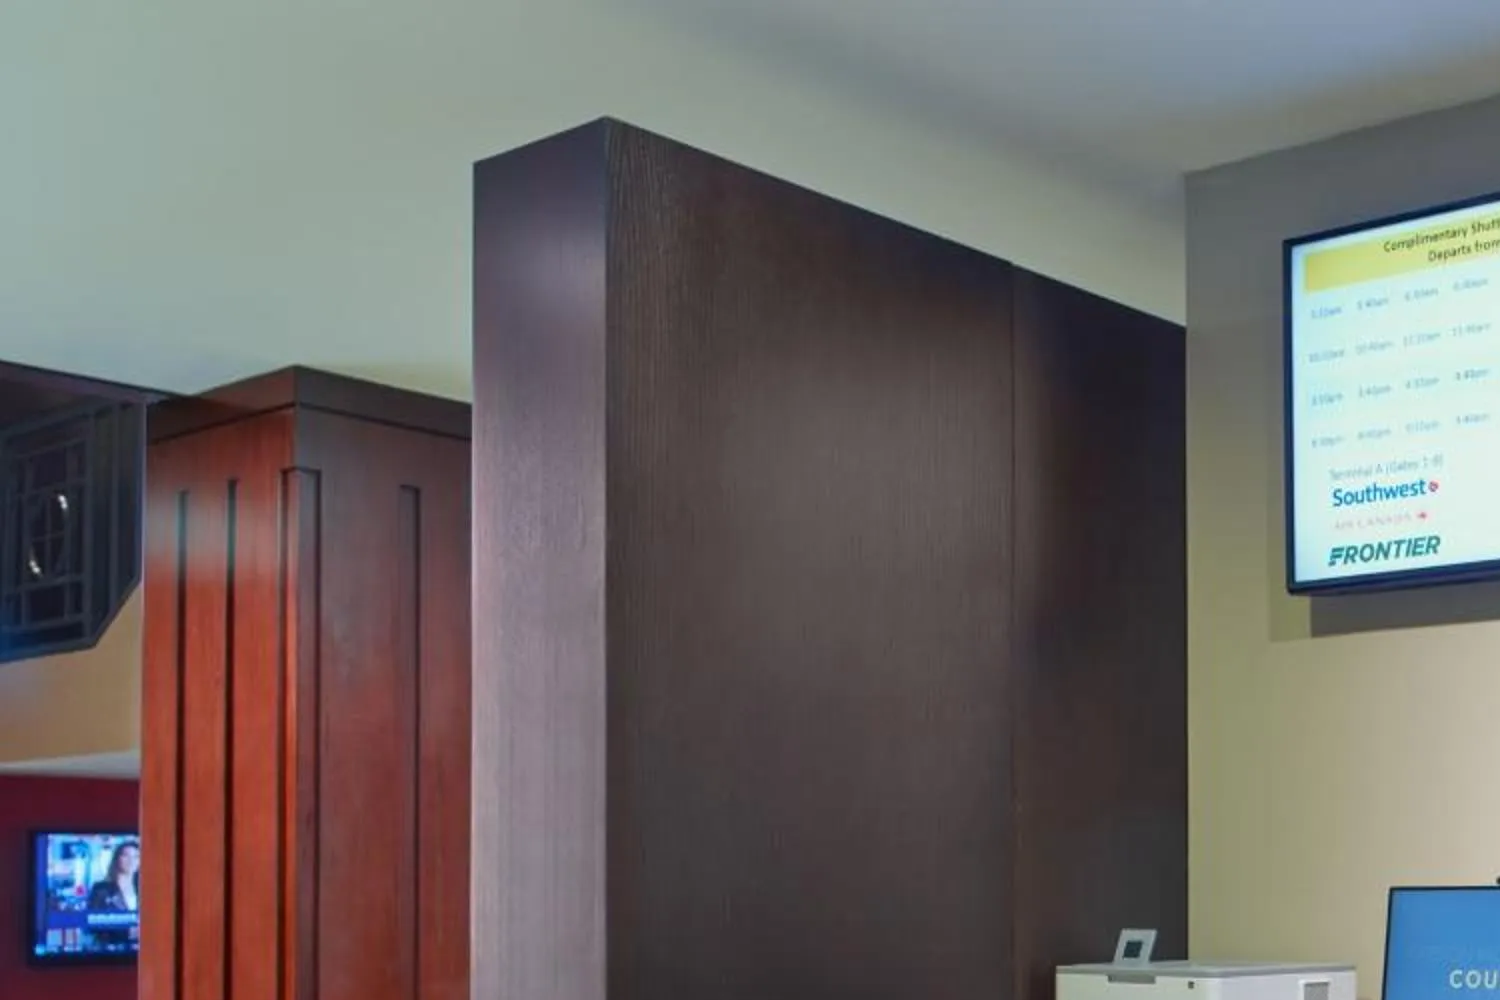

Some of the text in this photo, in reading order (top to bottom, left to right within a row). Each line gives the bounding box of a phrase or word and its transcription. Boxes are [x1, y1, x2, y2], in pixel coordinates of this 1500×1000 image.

[1384, 226, 1468, 252] Complimentary
[1428, 244, 1472, 263] Departs
[1332, 478, 1426, 507] Southwest
[1328, 534, 1441, 567] FRONTIER
